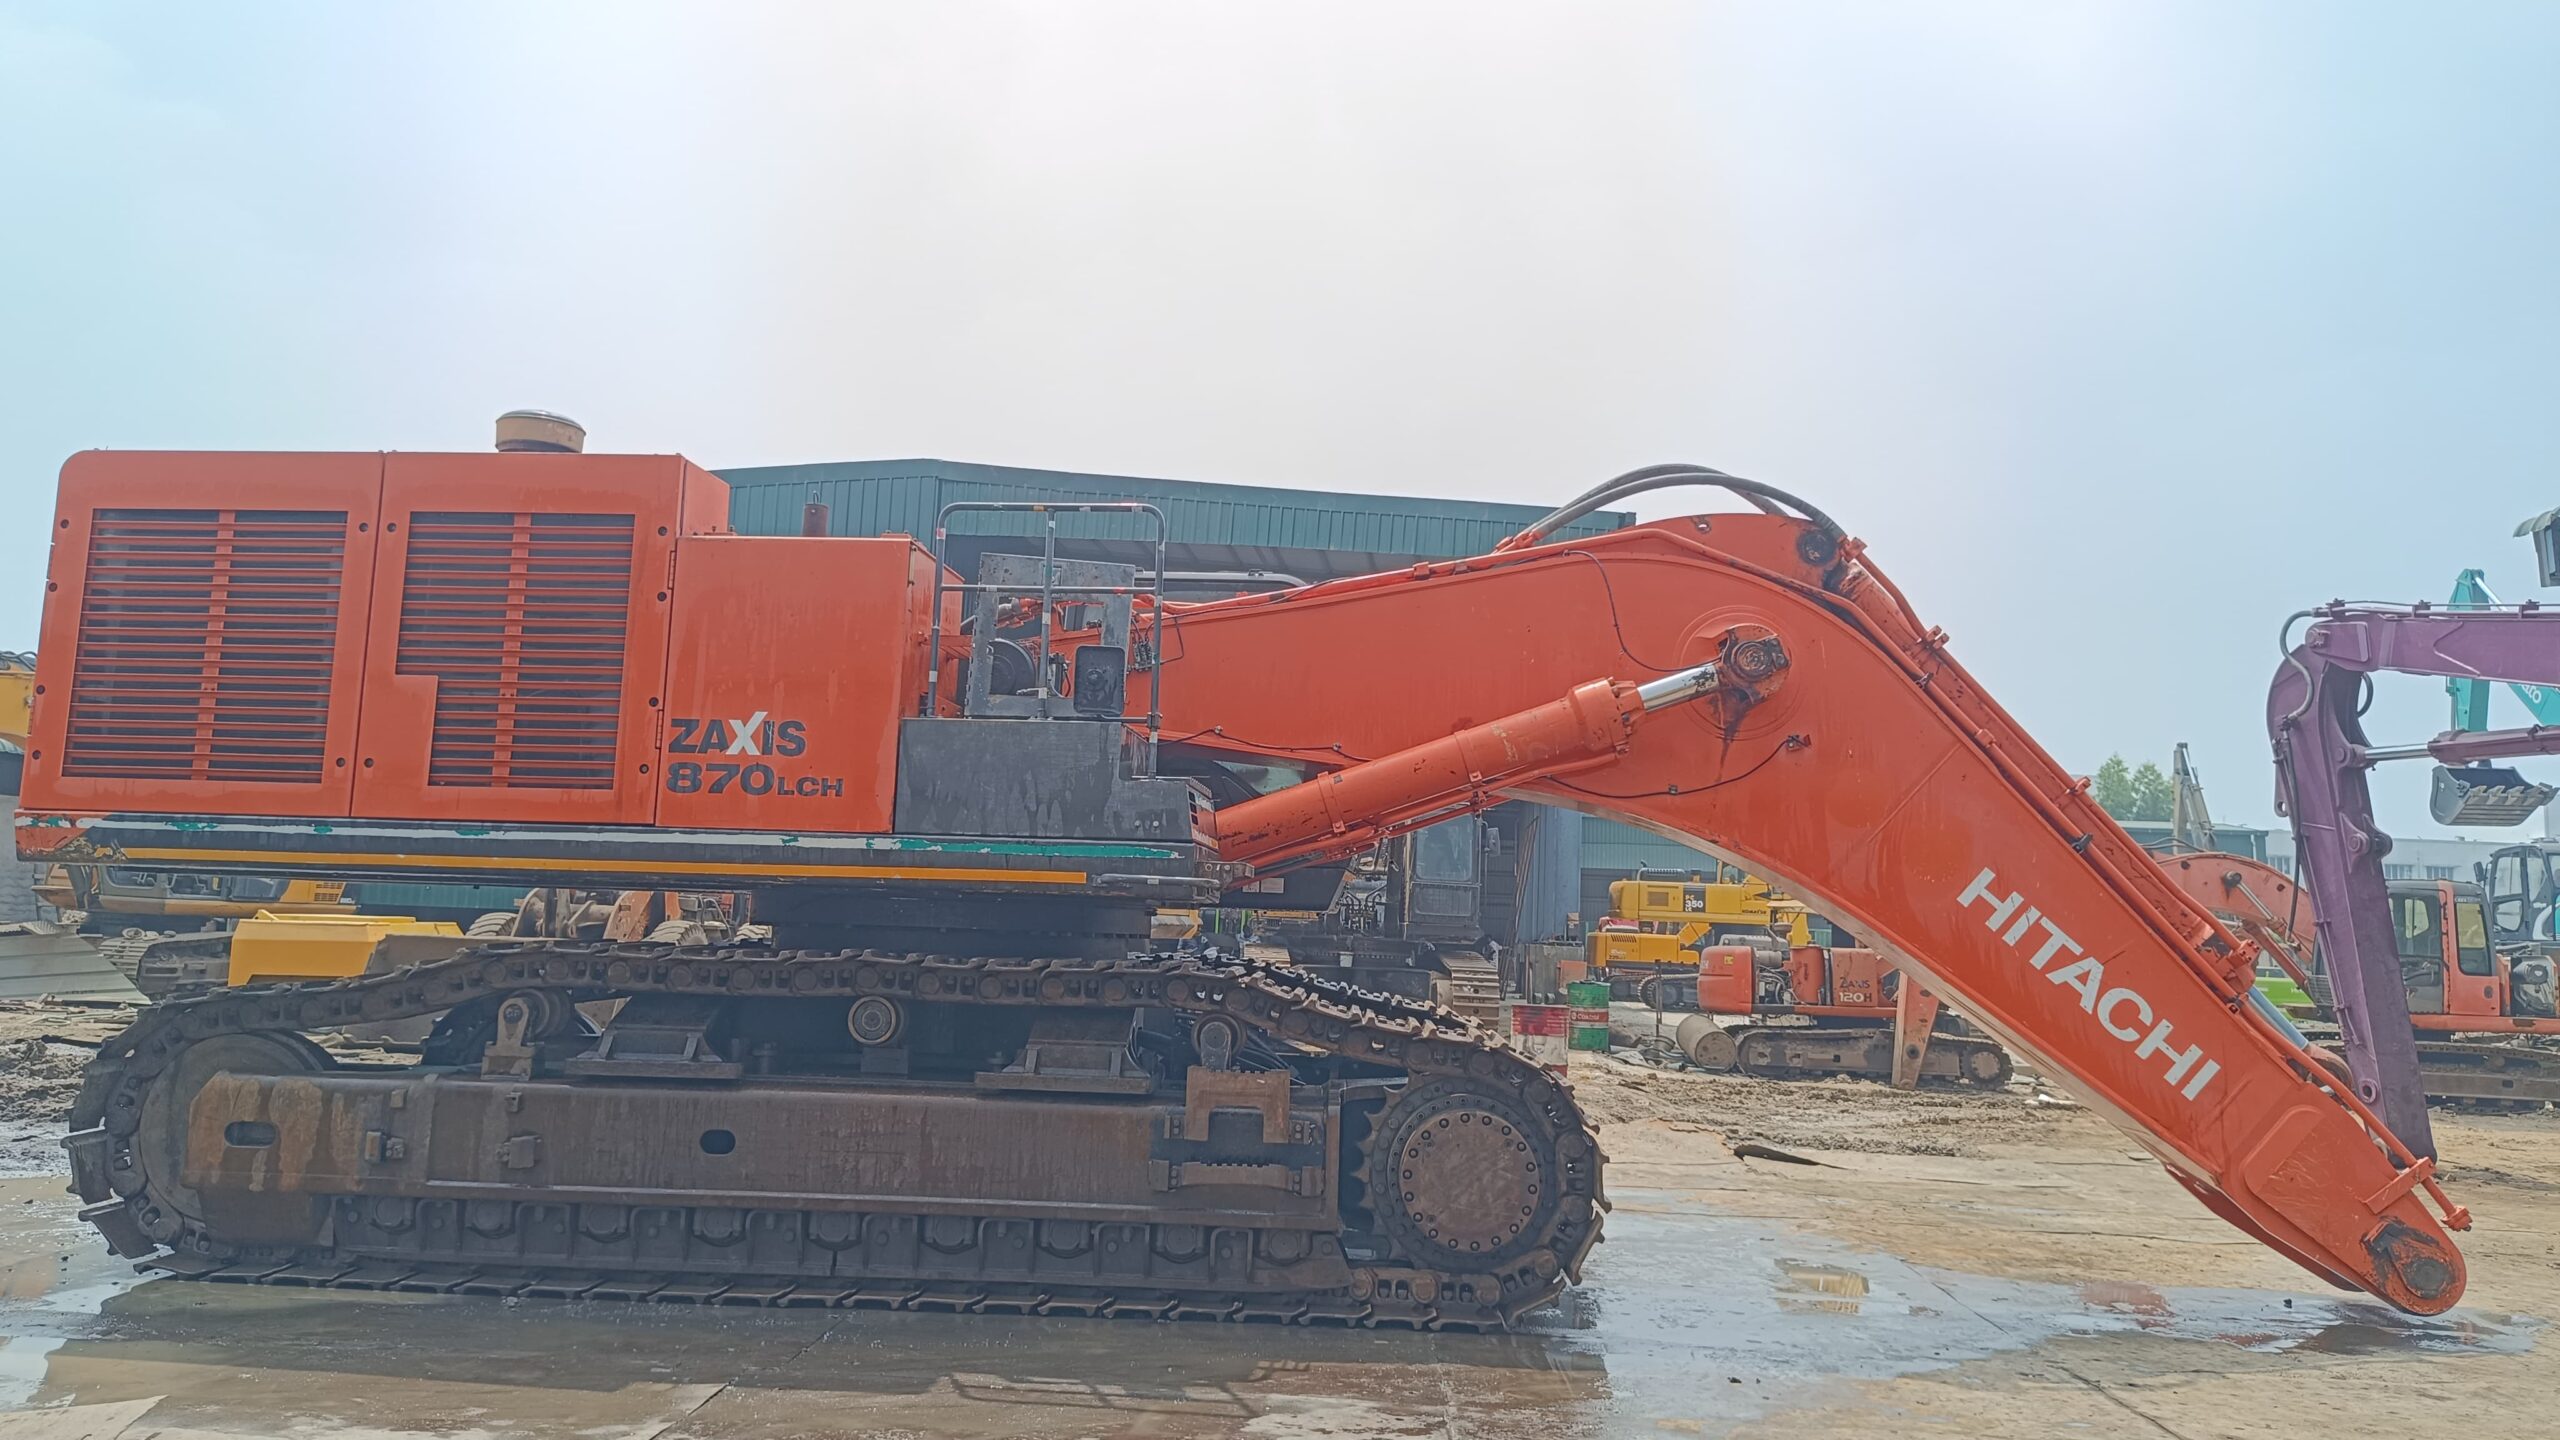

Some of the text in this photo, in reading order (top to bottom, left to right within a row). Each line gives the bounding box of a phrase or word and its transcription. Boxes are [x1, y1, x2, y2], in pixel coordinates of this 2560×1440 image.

[668, 711, 806, 757] ZAXIS
[666, 762, 843, 797] 870LCH
[1685, 900, 1704, 908] 350
[1839, 991, 1873, 1003] 120H
[1956, 867, 2221, 1101] HITACHI
